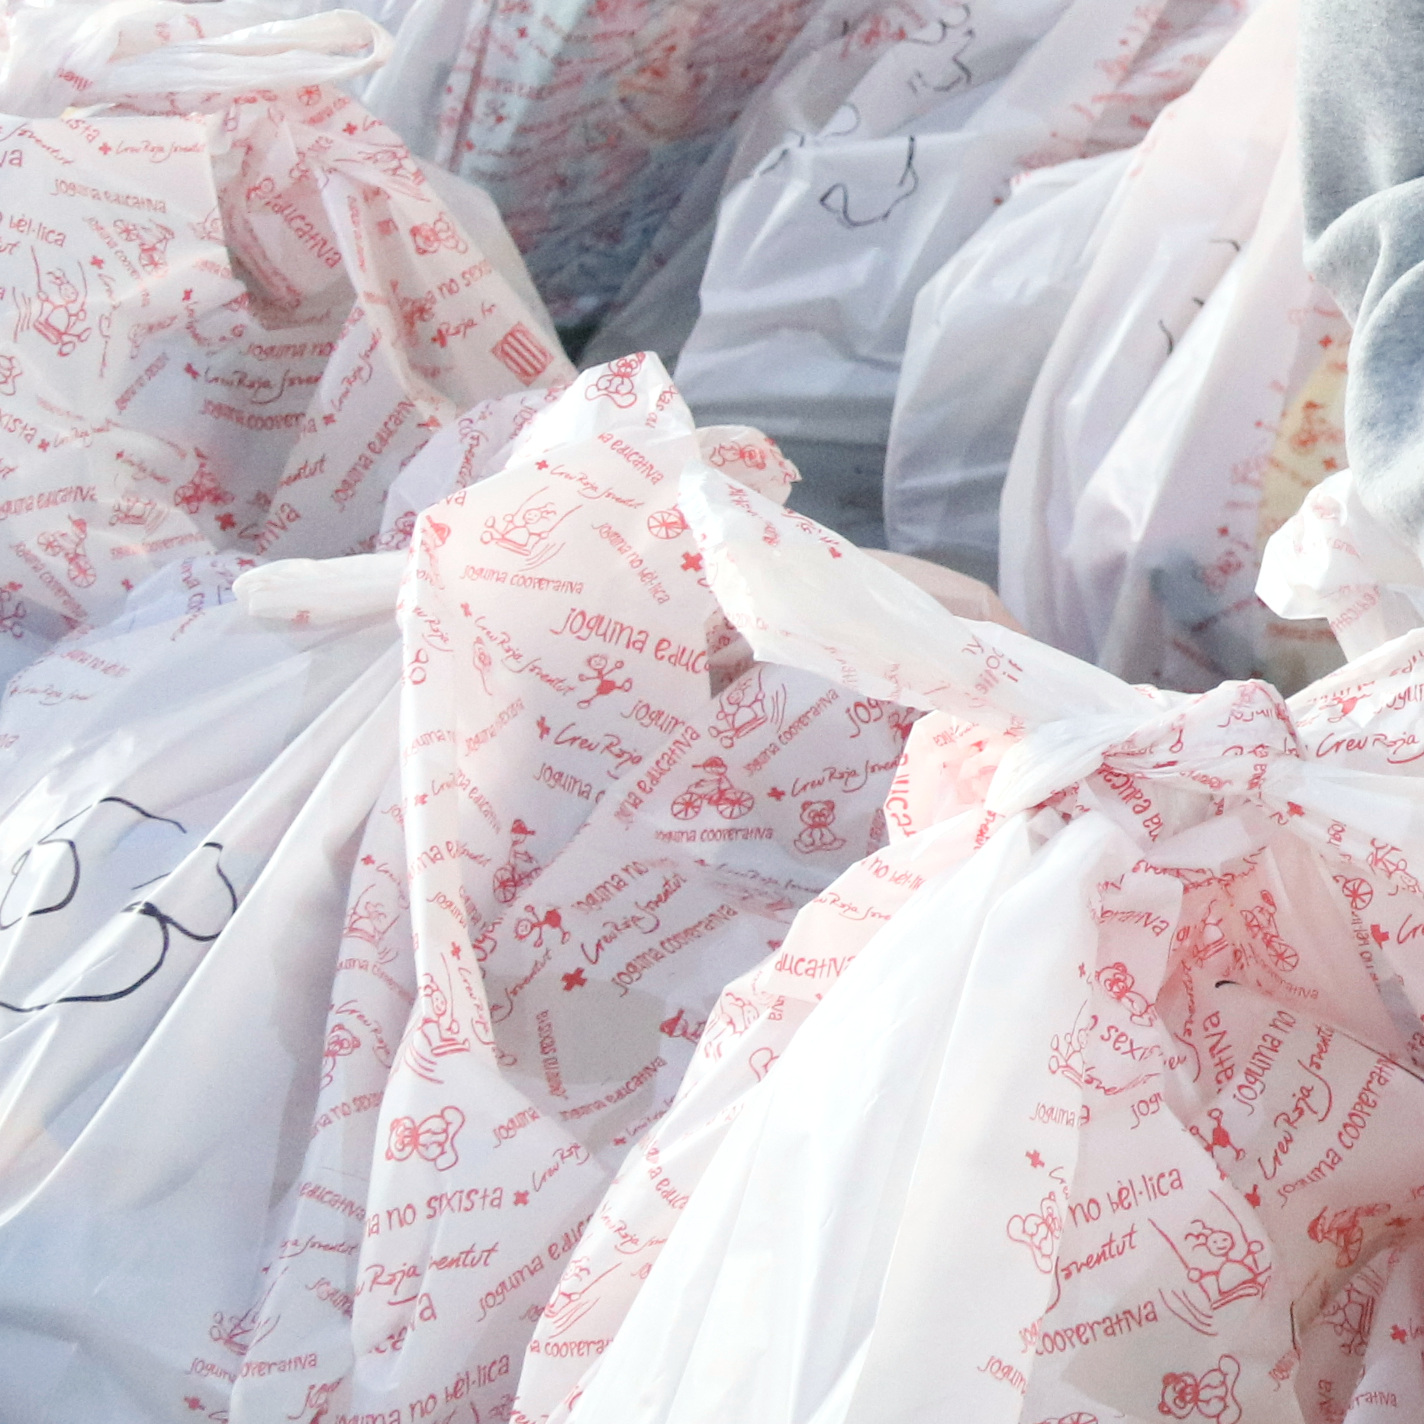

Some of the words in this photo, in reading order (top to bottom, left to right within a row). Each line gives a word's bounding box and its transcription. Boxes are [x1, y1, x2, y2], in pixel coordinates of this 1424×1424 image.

[6, 213, 67, 248] bèl·lica
[610, 436, 664, 486] educativa
[459, 564, 509, 585] joguina
[508, 570, 585, 595] cooperativa
[553, 721, 600, 754] Creu
[599, 732, 644, 768] Roja
[742, 740, 778, 777] joguina
[776, 686, 842, 746] cooperativa
[532, 761, 593, 802] joguina
[631, 725, 702, 797] educativa
[700, 826, 775, 843] cooperativa
[570, 872, 629, 915] joguina
[621, 859, 650, 885] no
[611, 948, 665, 998] joguina
[661, 902, 740, 958] cooperativa
[1233, 1035, 1283, 1117] joguina
[1267, 1009, 1298, 1038] no
[298, 1181, 367, 1223] educativa
[386, 1203, 418, 1231] no
[1066, 1196, 1102, 1229] no
[1105, 1166, 1184, 1213] bèl·lica
[363, 1262, 421, 1297] Roja
[476, 1257, 545, 1324] joguina
[408, 1392, 438, 1423] no
[444, 1353, 511, 1403] bèl·lica
